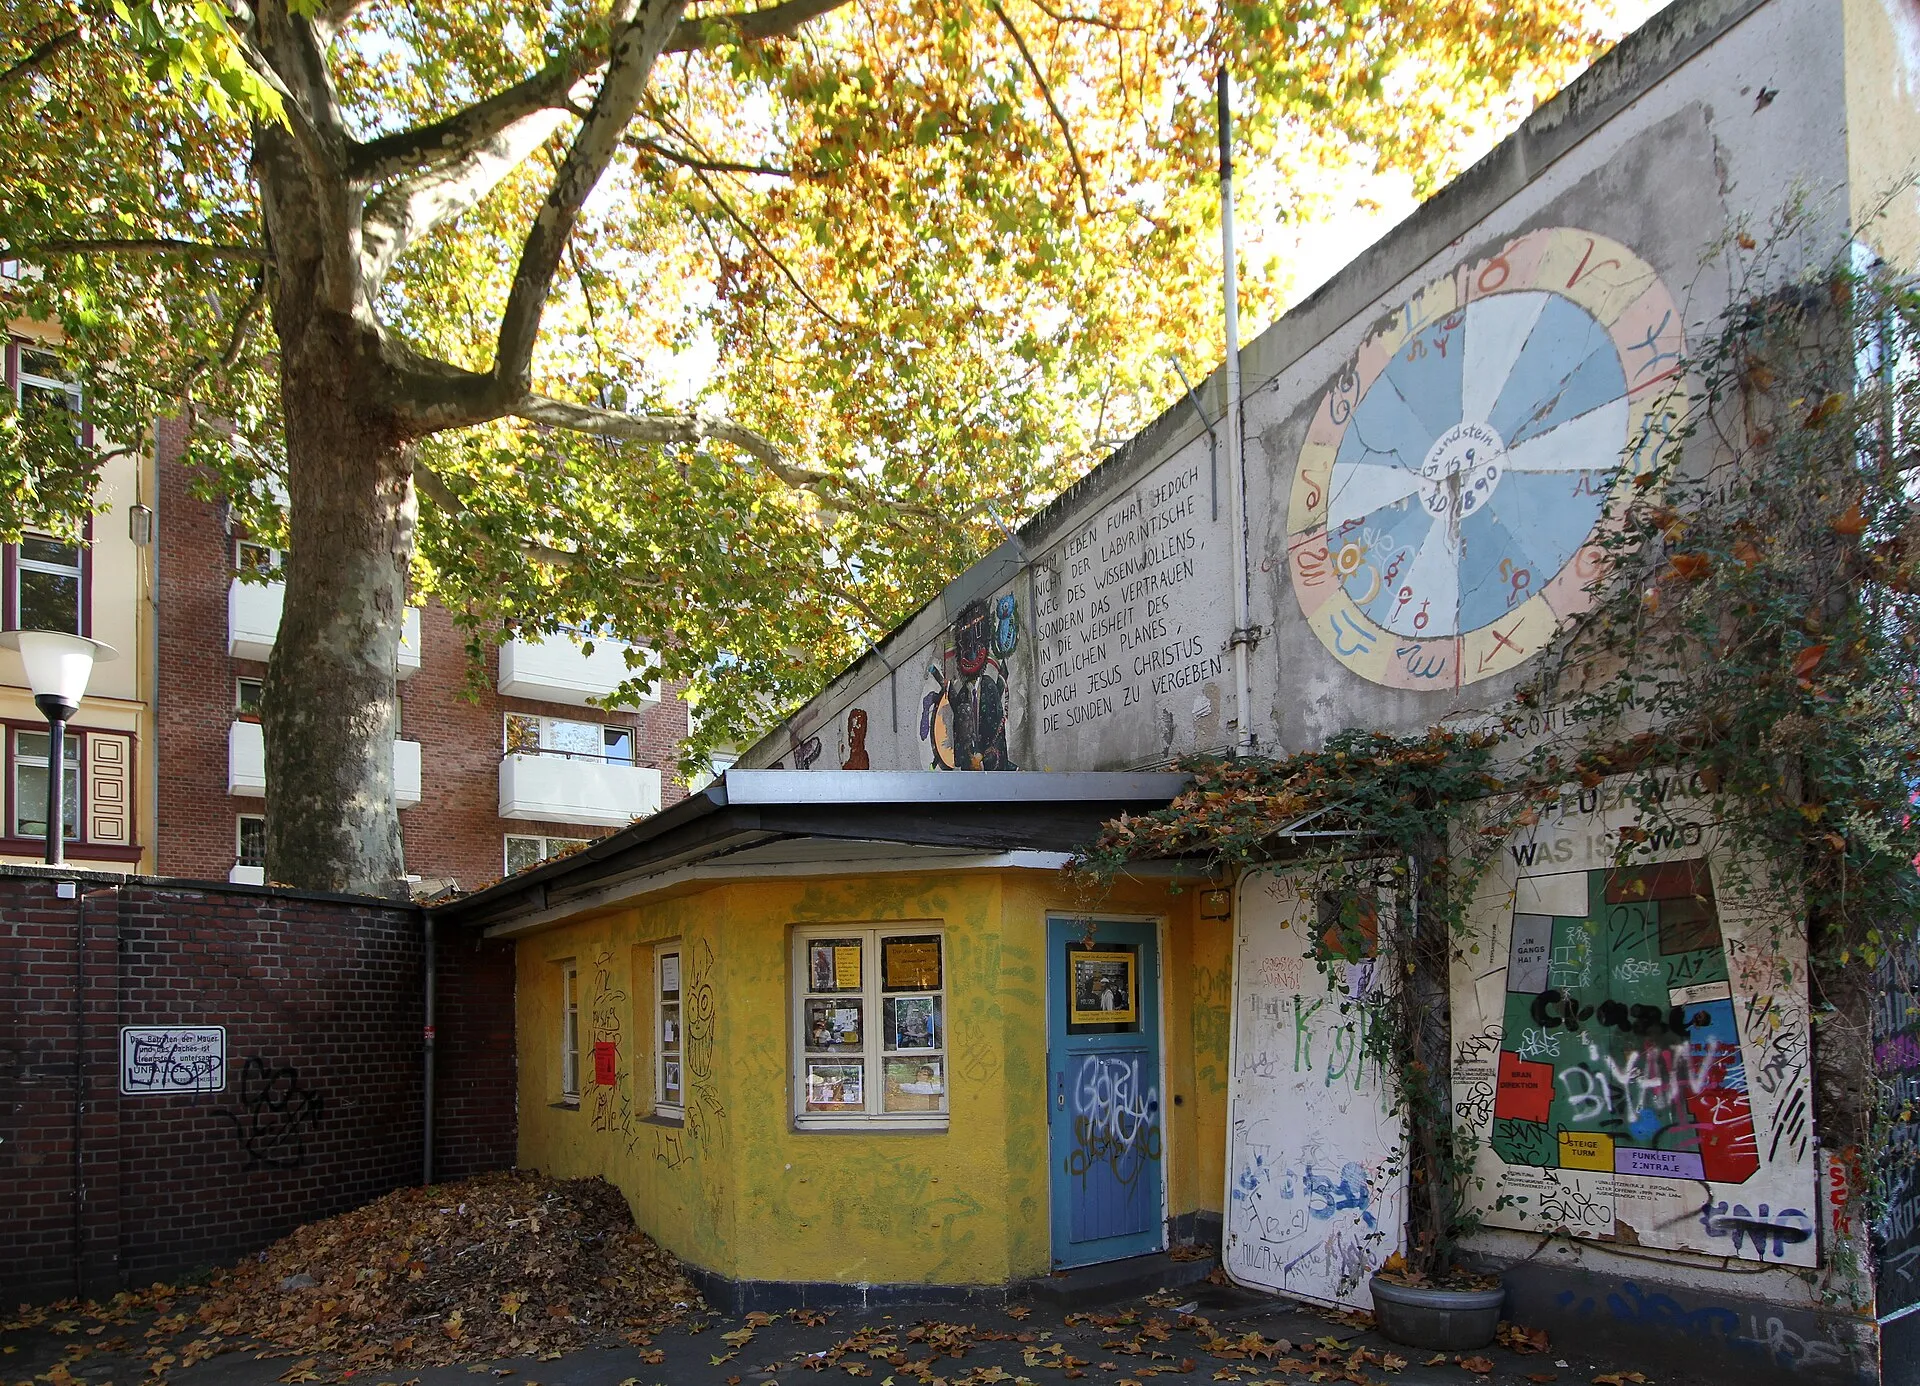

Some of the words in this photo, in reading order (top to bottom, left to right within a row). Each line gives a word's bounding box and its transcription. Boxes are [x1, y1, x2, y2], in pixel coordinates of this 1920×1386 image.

[1423, 424, 1494, 477] Grundstein
[1035, 553, 1057, 578] ZUM
[1064, 527, 1097, 560] LEBEN
[1152, 466, 1198, 508] JEDOCH
[1035, 571, 1062, 599] NICHT
[1072, 557, 1091, 579] DER
[1101, 495, 1195, 562] LABYRINTISCHE
[1036, 597, 1059, 618] WEG
[1067, 582, 1086, 604] DES
[1039, 608, 1084, 641] SONDERN
[1091, 595, 1110, 618] DAS
[1121, 558, 1194, 604] VERTRAUEN
[1040, 648, 1051, 665] IN
[1057, 635, 1073, 656] DIE
[1080, 607, 1134, 644] WEISHEIT
[1148, 594, 1169, 617] DES
[1043, 683, 1077, 710] DURCH
[1087, 664, 1122, 694] JESUS
[1134, 635, 1203, 677] CHRISTUS
[1043, 713, 1059, 734] DIE
[1123, 685, 1140, 707] ZU
[1152, 654, 1231, 695] VERGEBEN.
[1512, 836, 1574, 867] WAS
[1517, 946, 1545, 954] GANGS
[182, 1035, 193, 1043] der
[197, 1035, 219, 1043] Mauer
[201, 1044, 210, 1052] ist
[1568, 1140, 1598, 1149] STEIGE
[1572, 1149, 1596, 1157] TURM
[1632, 1151, 1677, 1162] FUNKLEIT
[1632, 1161, 1680, 1172] ZNTRAE
